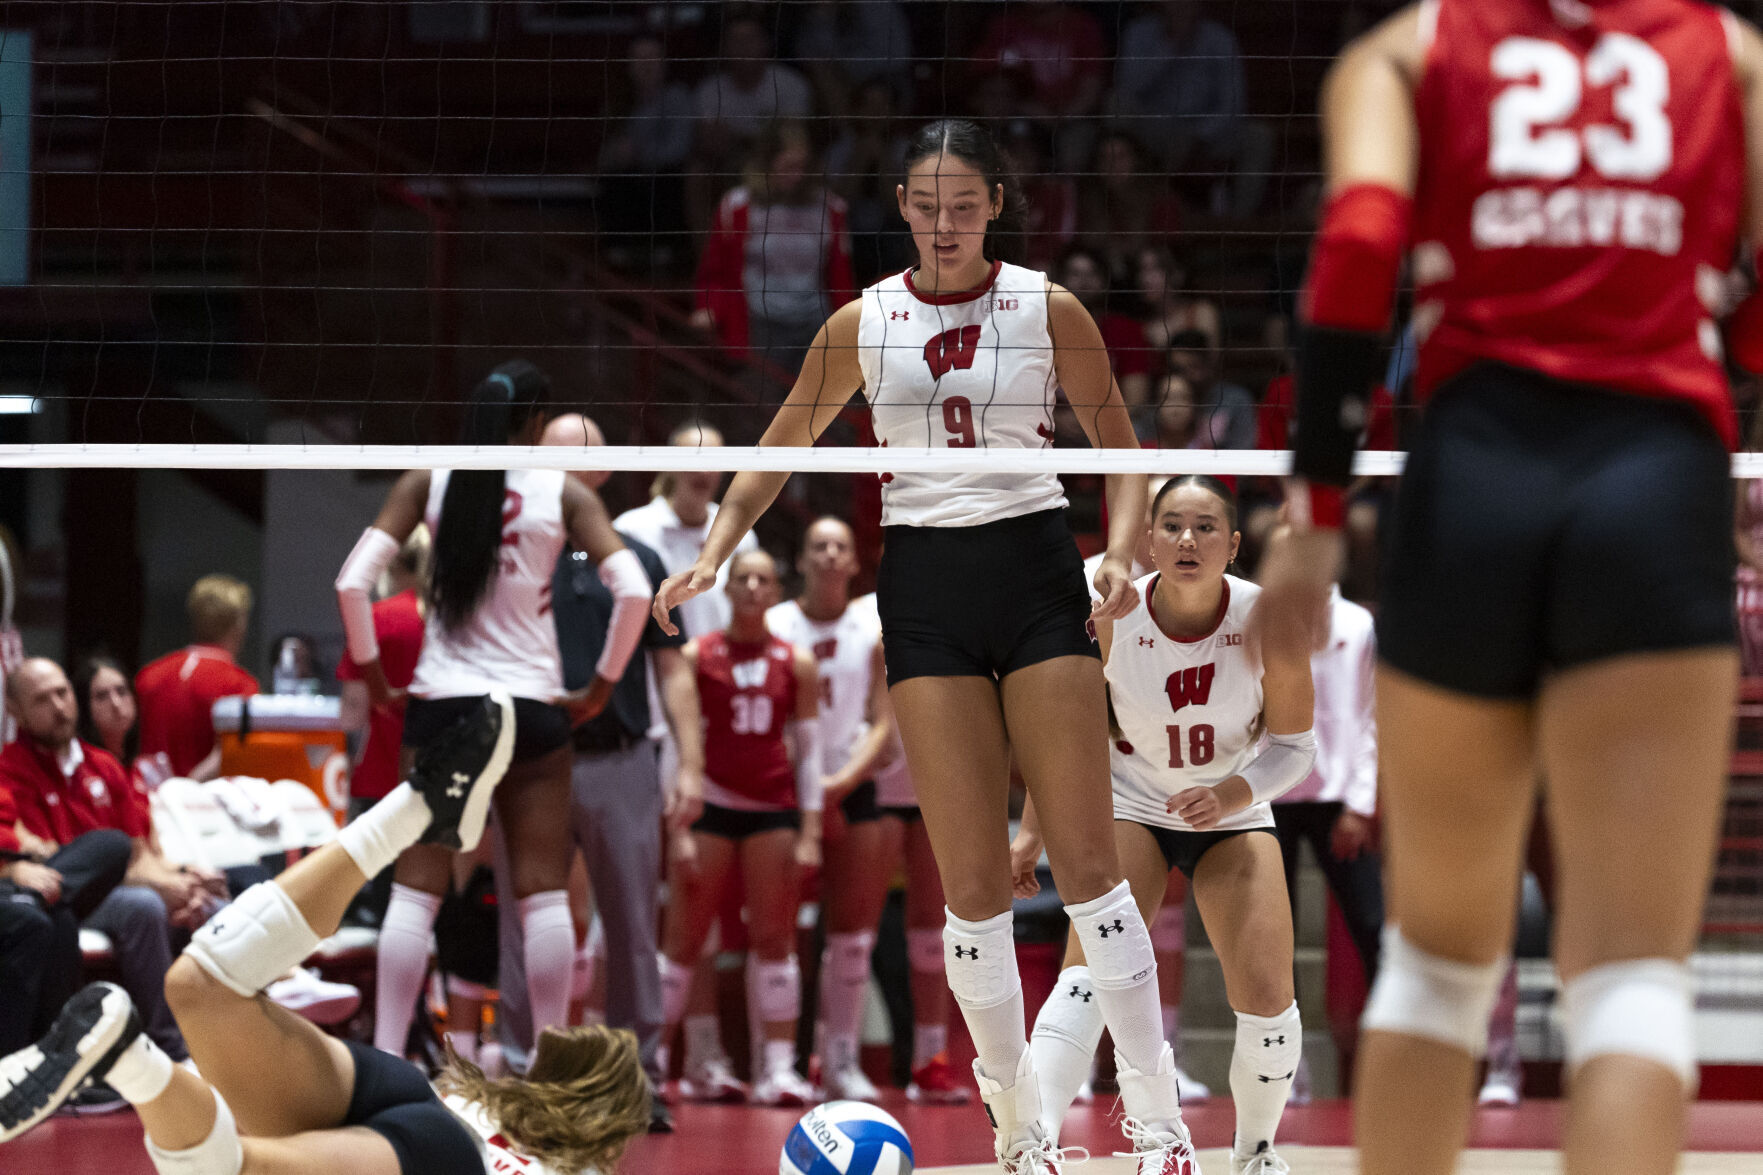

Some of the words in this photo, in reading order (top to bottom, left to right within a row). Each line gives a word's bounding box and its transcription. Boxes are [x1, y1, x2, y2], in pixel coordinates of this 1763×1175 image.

[1488, 33, 1673, 181] 23
[923, 325, 981, 382] W
[942, 396, 976, 448] 9
[1165, 662, 1215, 713] W
[1166, 724, 1214, 768] 18
